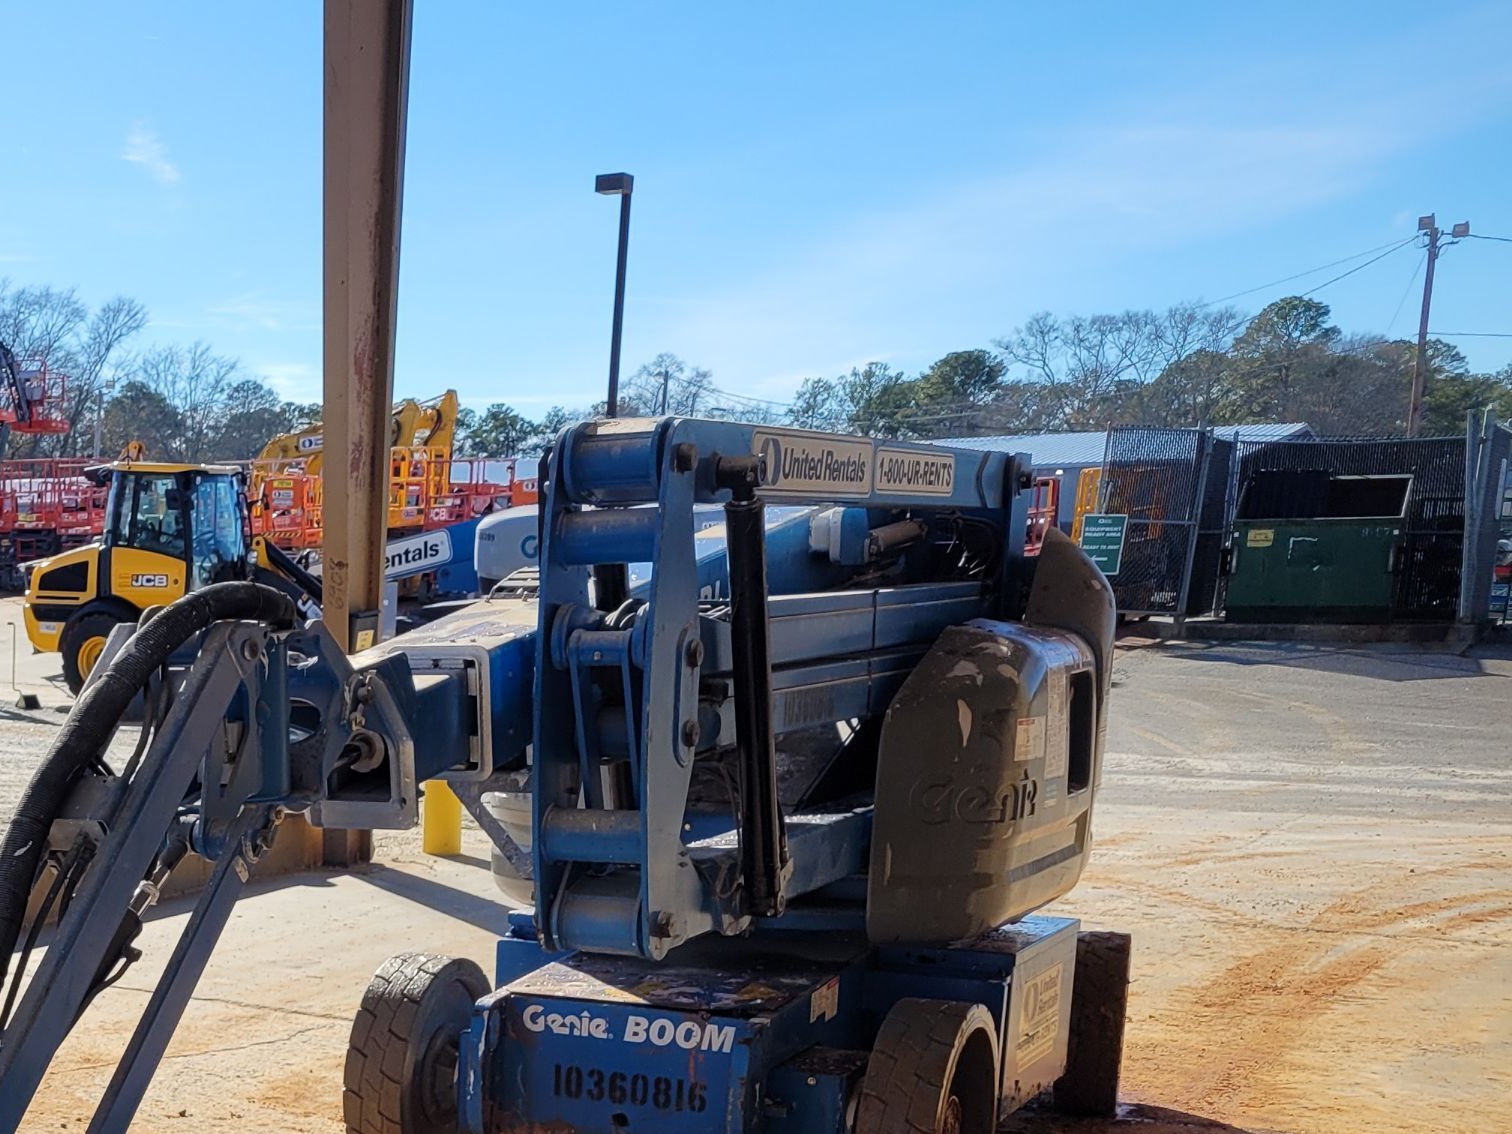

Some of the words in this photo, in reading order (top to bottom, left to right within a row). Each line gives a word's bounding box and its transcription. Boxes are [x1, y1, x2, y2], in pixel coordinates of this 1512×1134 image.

[782, 446, 824, 481] United
[823, 449, 866, 483] Rentals
[879, 456, 953, 488] 1-800-UR-RENTS
[131, 575, 168, 587] JCB
[522, 1004, 609, 1040] Genie
[623, 1015, 737, 1054] BOOM
[553, 1063, 708, 1113] 10360816
